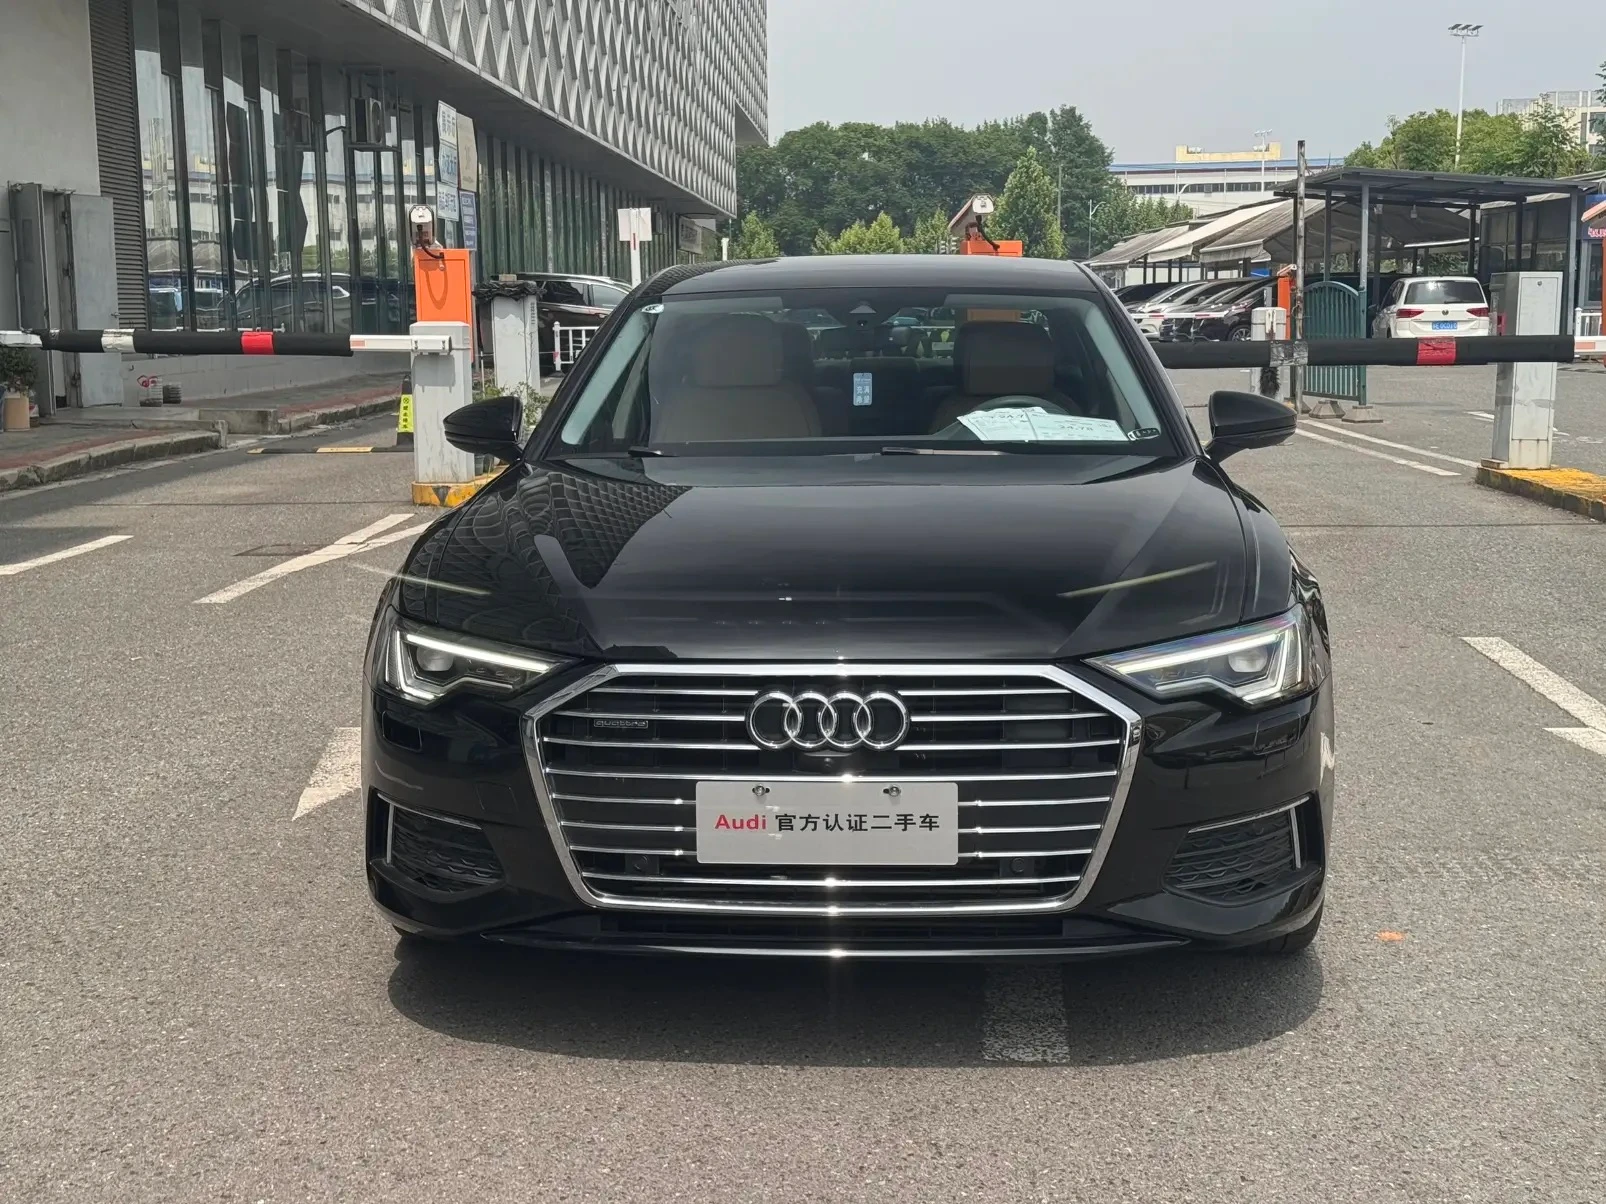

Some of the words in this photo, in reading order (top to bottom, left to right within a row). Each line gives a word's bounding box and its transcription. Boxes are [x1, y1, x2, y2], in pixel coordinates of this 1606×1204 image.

[595, 720, 647, 728] quattro
[714, 814, 767, 830] Audi
[775, 813, 940, 832] 官方认证二手车
